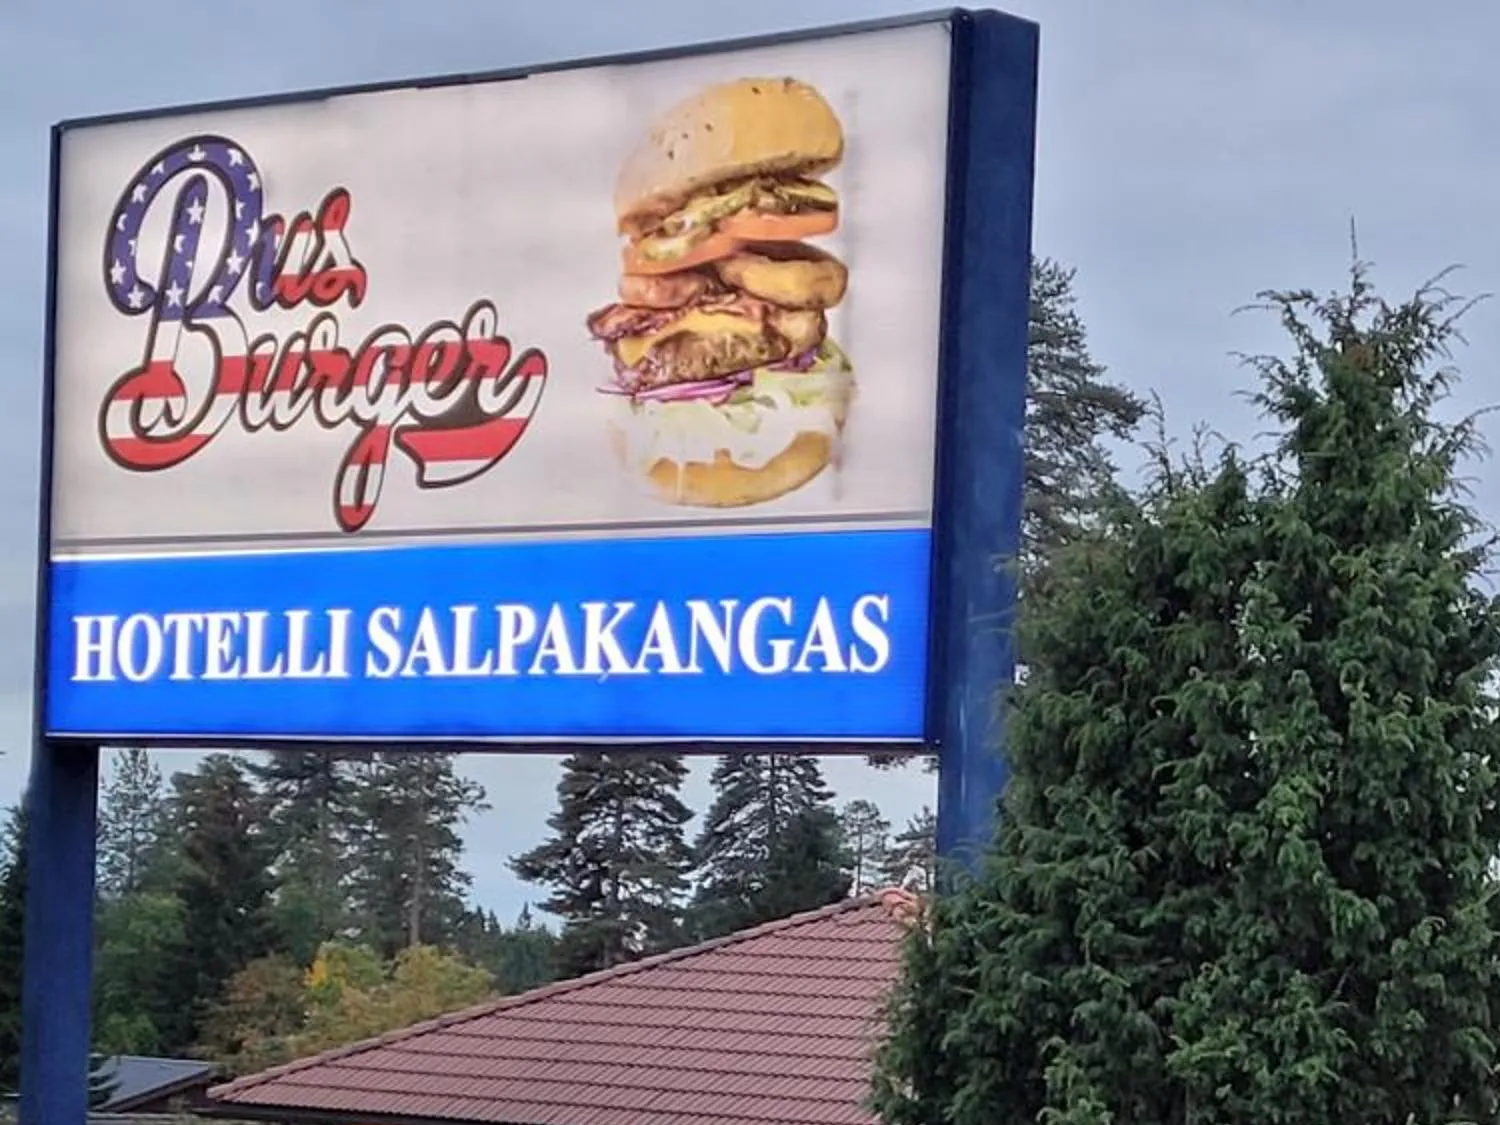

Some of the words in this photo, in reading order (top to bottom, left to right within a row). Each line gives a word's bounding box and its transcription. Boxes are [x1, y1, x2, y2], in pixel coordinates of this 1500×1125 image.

[102, 135, 368, 310] Bus
[98, 299, 548, 533] Burger
[70, 608, 352, 682] HOTELLI
[365, 594, 891, 679] SALPAKANGAS
